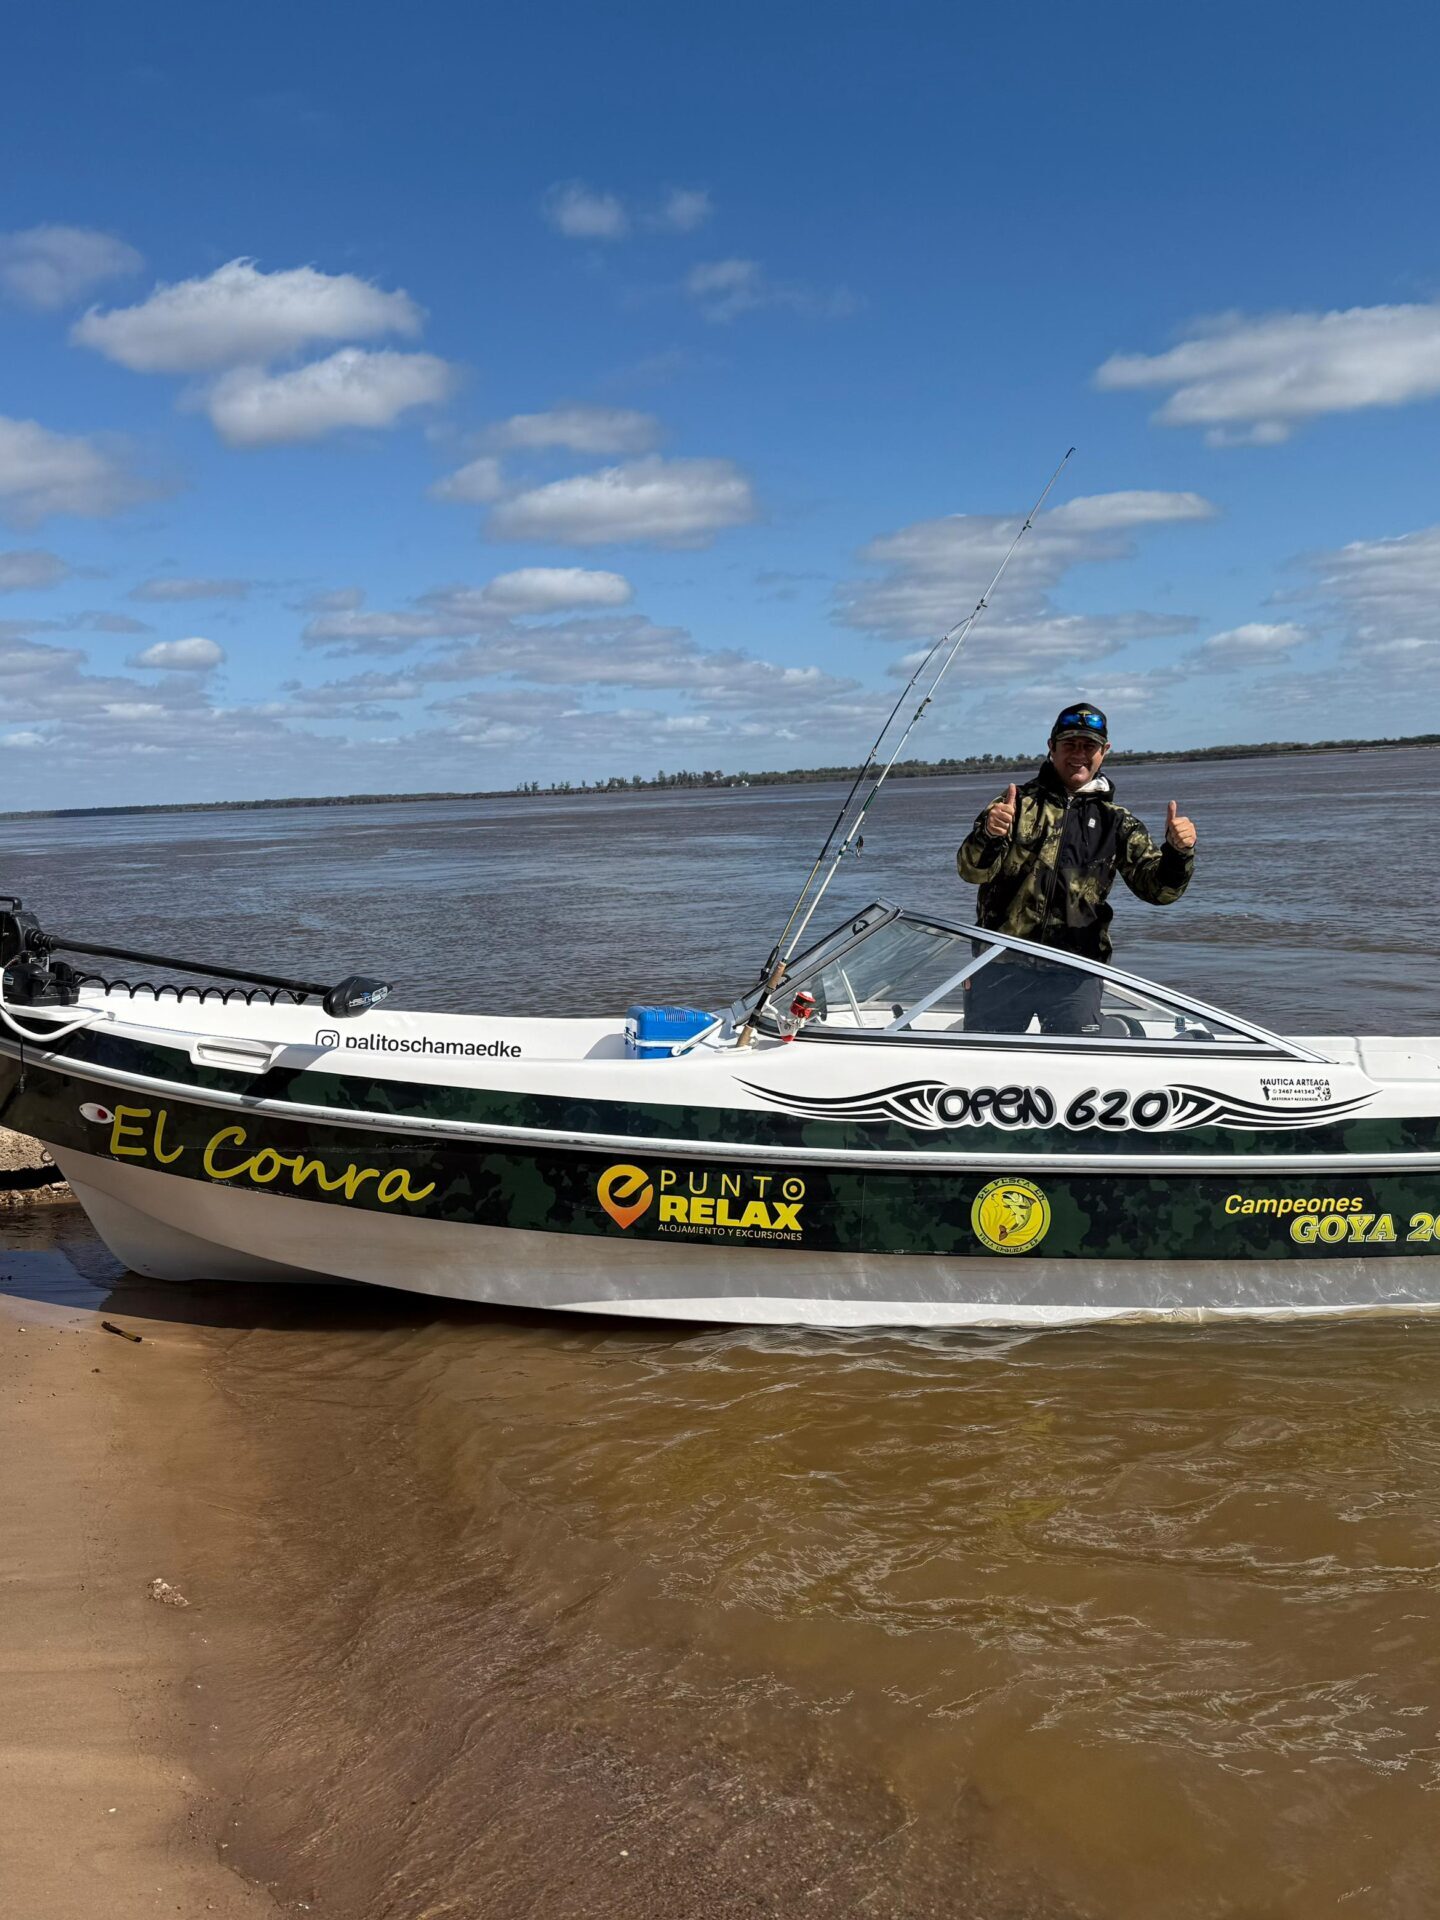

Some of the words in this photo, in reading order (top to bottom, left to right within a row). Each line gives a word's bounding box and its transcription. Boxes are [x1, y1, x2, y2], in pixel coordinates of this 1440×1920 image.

[346, 1034, 522, 1058] palitoschamaedke
[1260, 1078, 1294, 1086] NAUTICA
[1296, 1078, 1329, 1086] ARTEAGA
[1064, 1086, 1172, 1129] 620
[203, 1126, 436, 1204] Conra
[660, 1169, 806, 1201] PUNTO
[658, 1195, 804, 1231] RELAX
[1225, 1195, 1363, 1217] Campeones
[658, 1224, 725, 1236] ALOJAMIENTO
[727, 1228, 735, 1237] Y
[735, 1228, 802, 1241] EXCURSIONES
[1290, 1214, 1397, 1243] GOYA
